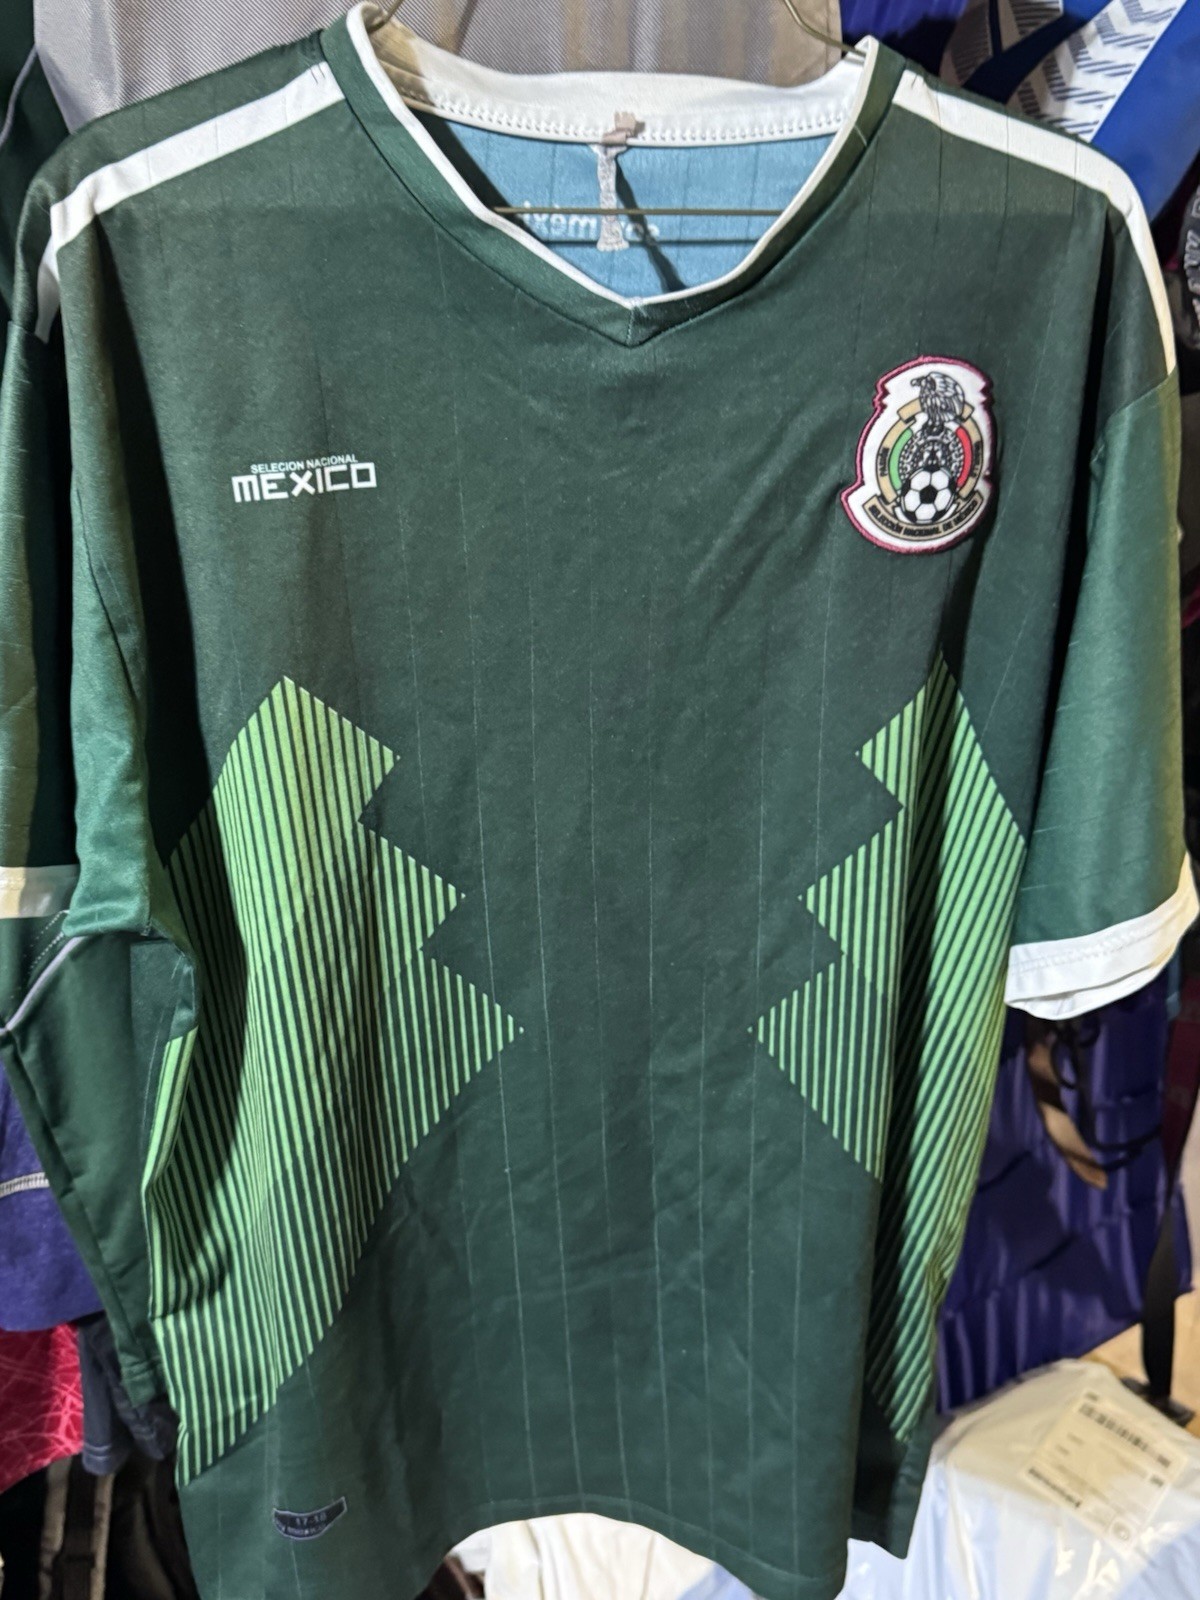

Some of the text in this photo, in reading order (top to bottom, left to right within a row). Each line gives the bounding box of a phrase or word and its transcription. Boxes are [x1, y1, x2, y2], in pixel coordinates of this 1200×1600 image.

[250, 453, 359, 475] SELECION NACIONAL
[231, 462, 378, 503] MEXICO
